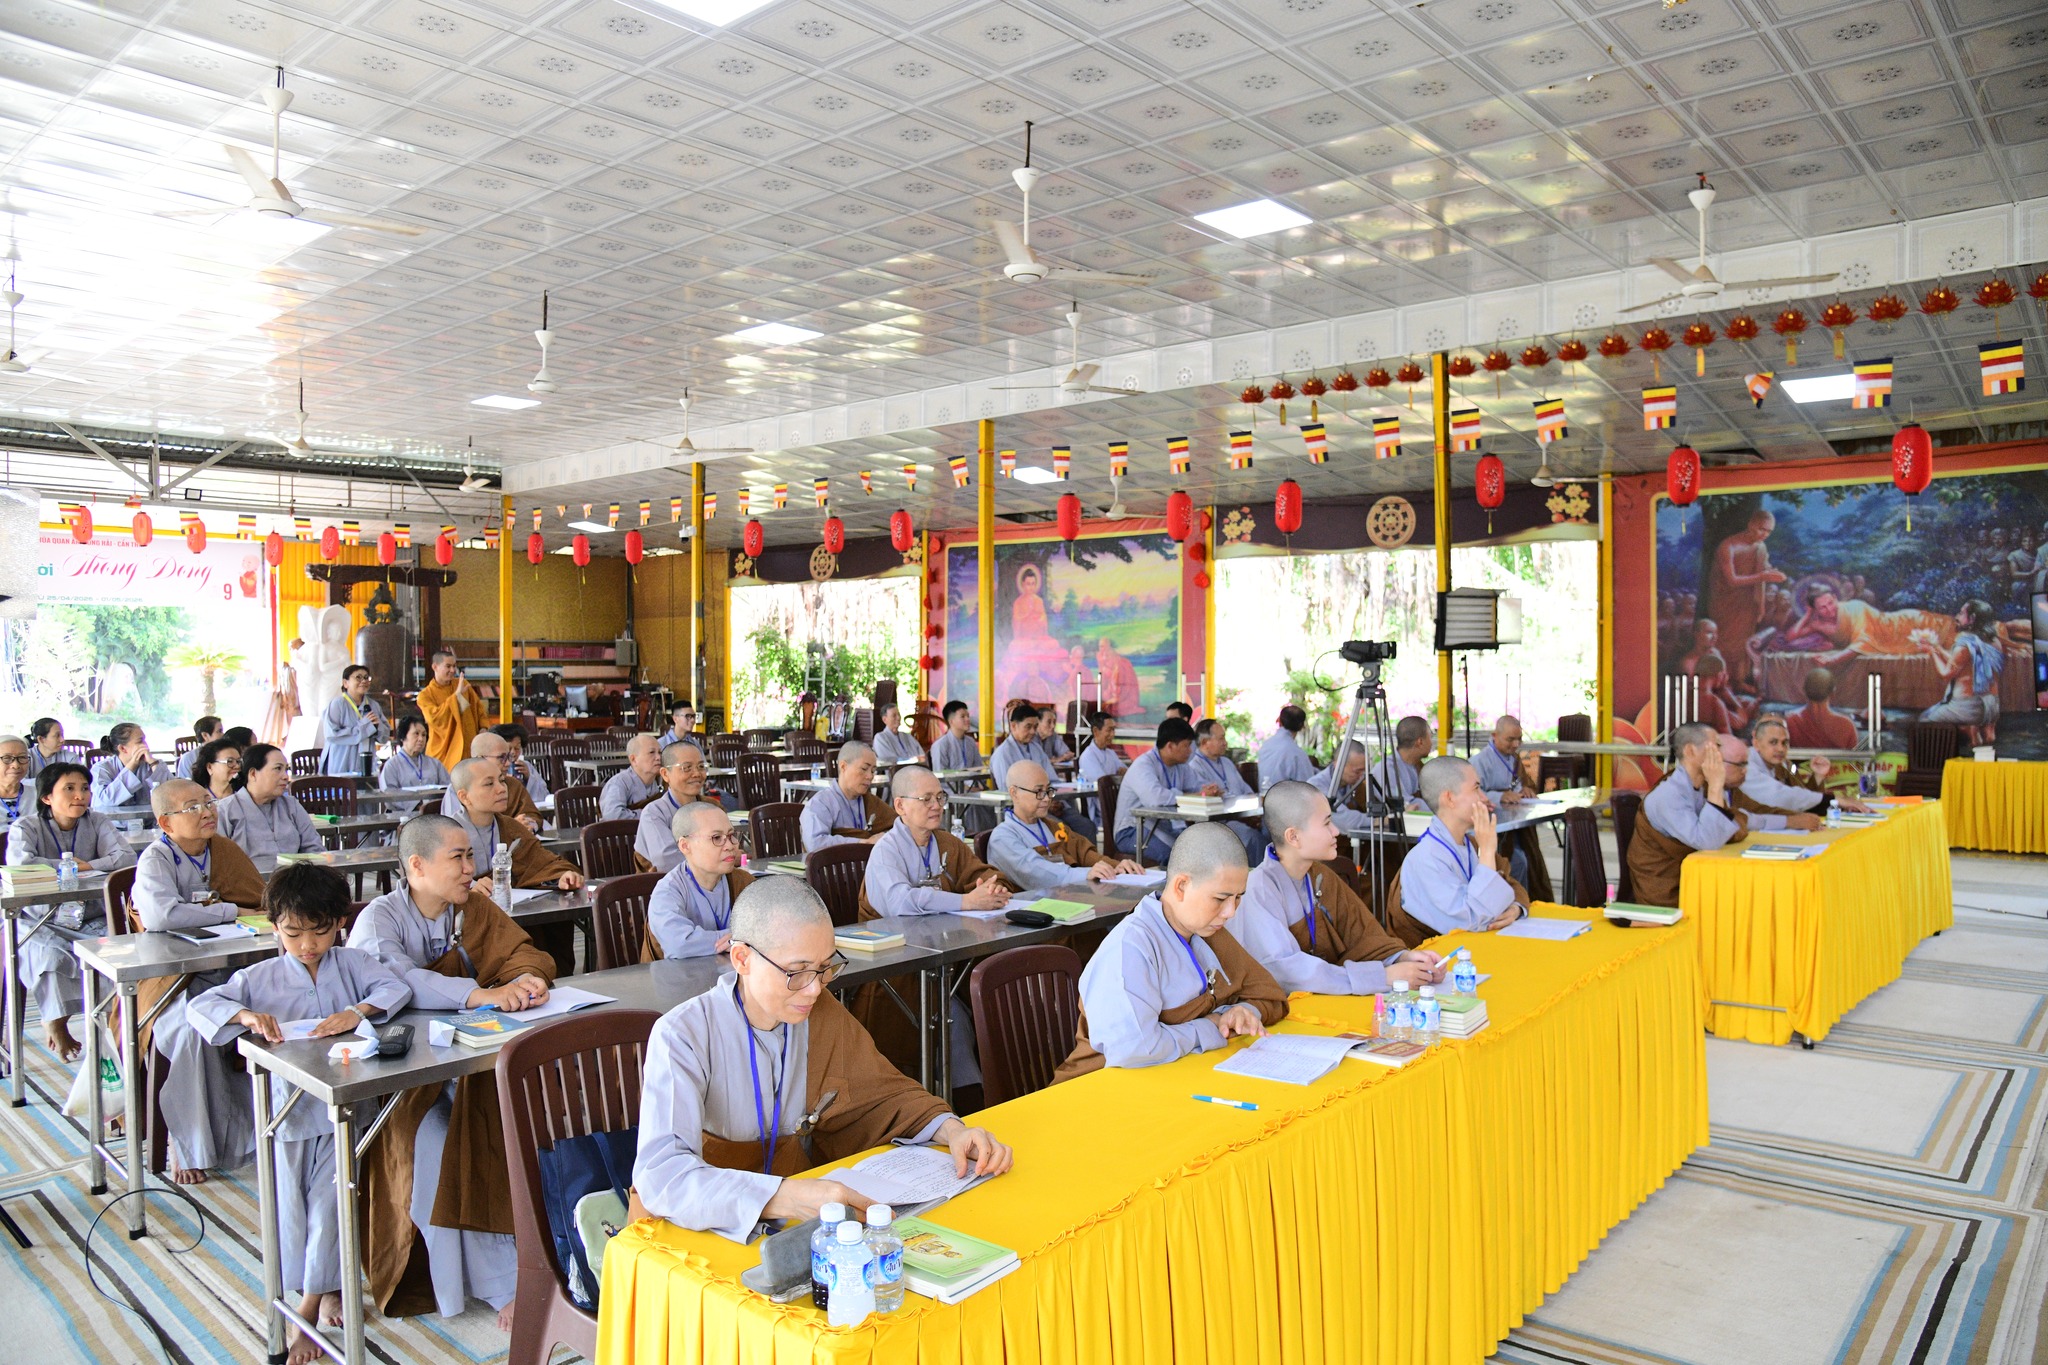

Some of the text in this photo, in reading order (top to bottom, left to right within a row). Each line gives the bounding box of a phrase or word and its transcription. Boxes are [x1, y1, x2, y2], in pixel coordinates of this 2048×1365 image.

[52, 537, 70, 545] QUAN
[63, 553, 138, 589] Thong
[146, 557, 212, 591] Dong
[223, 582, 233, 601] 9
